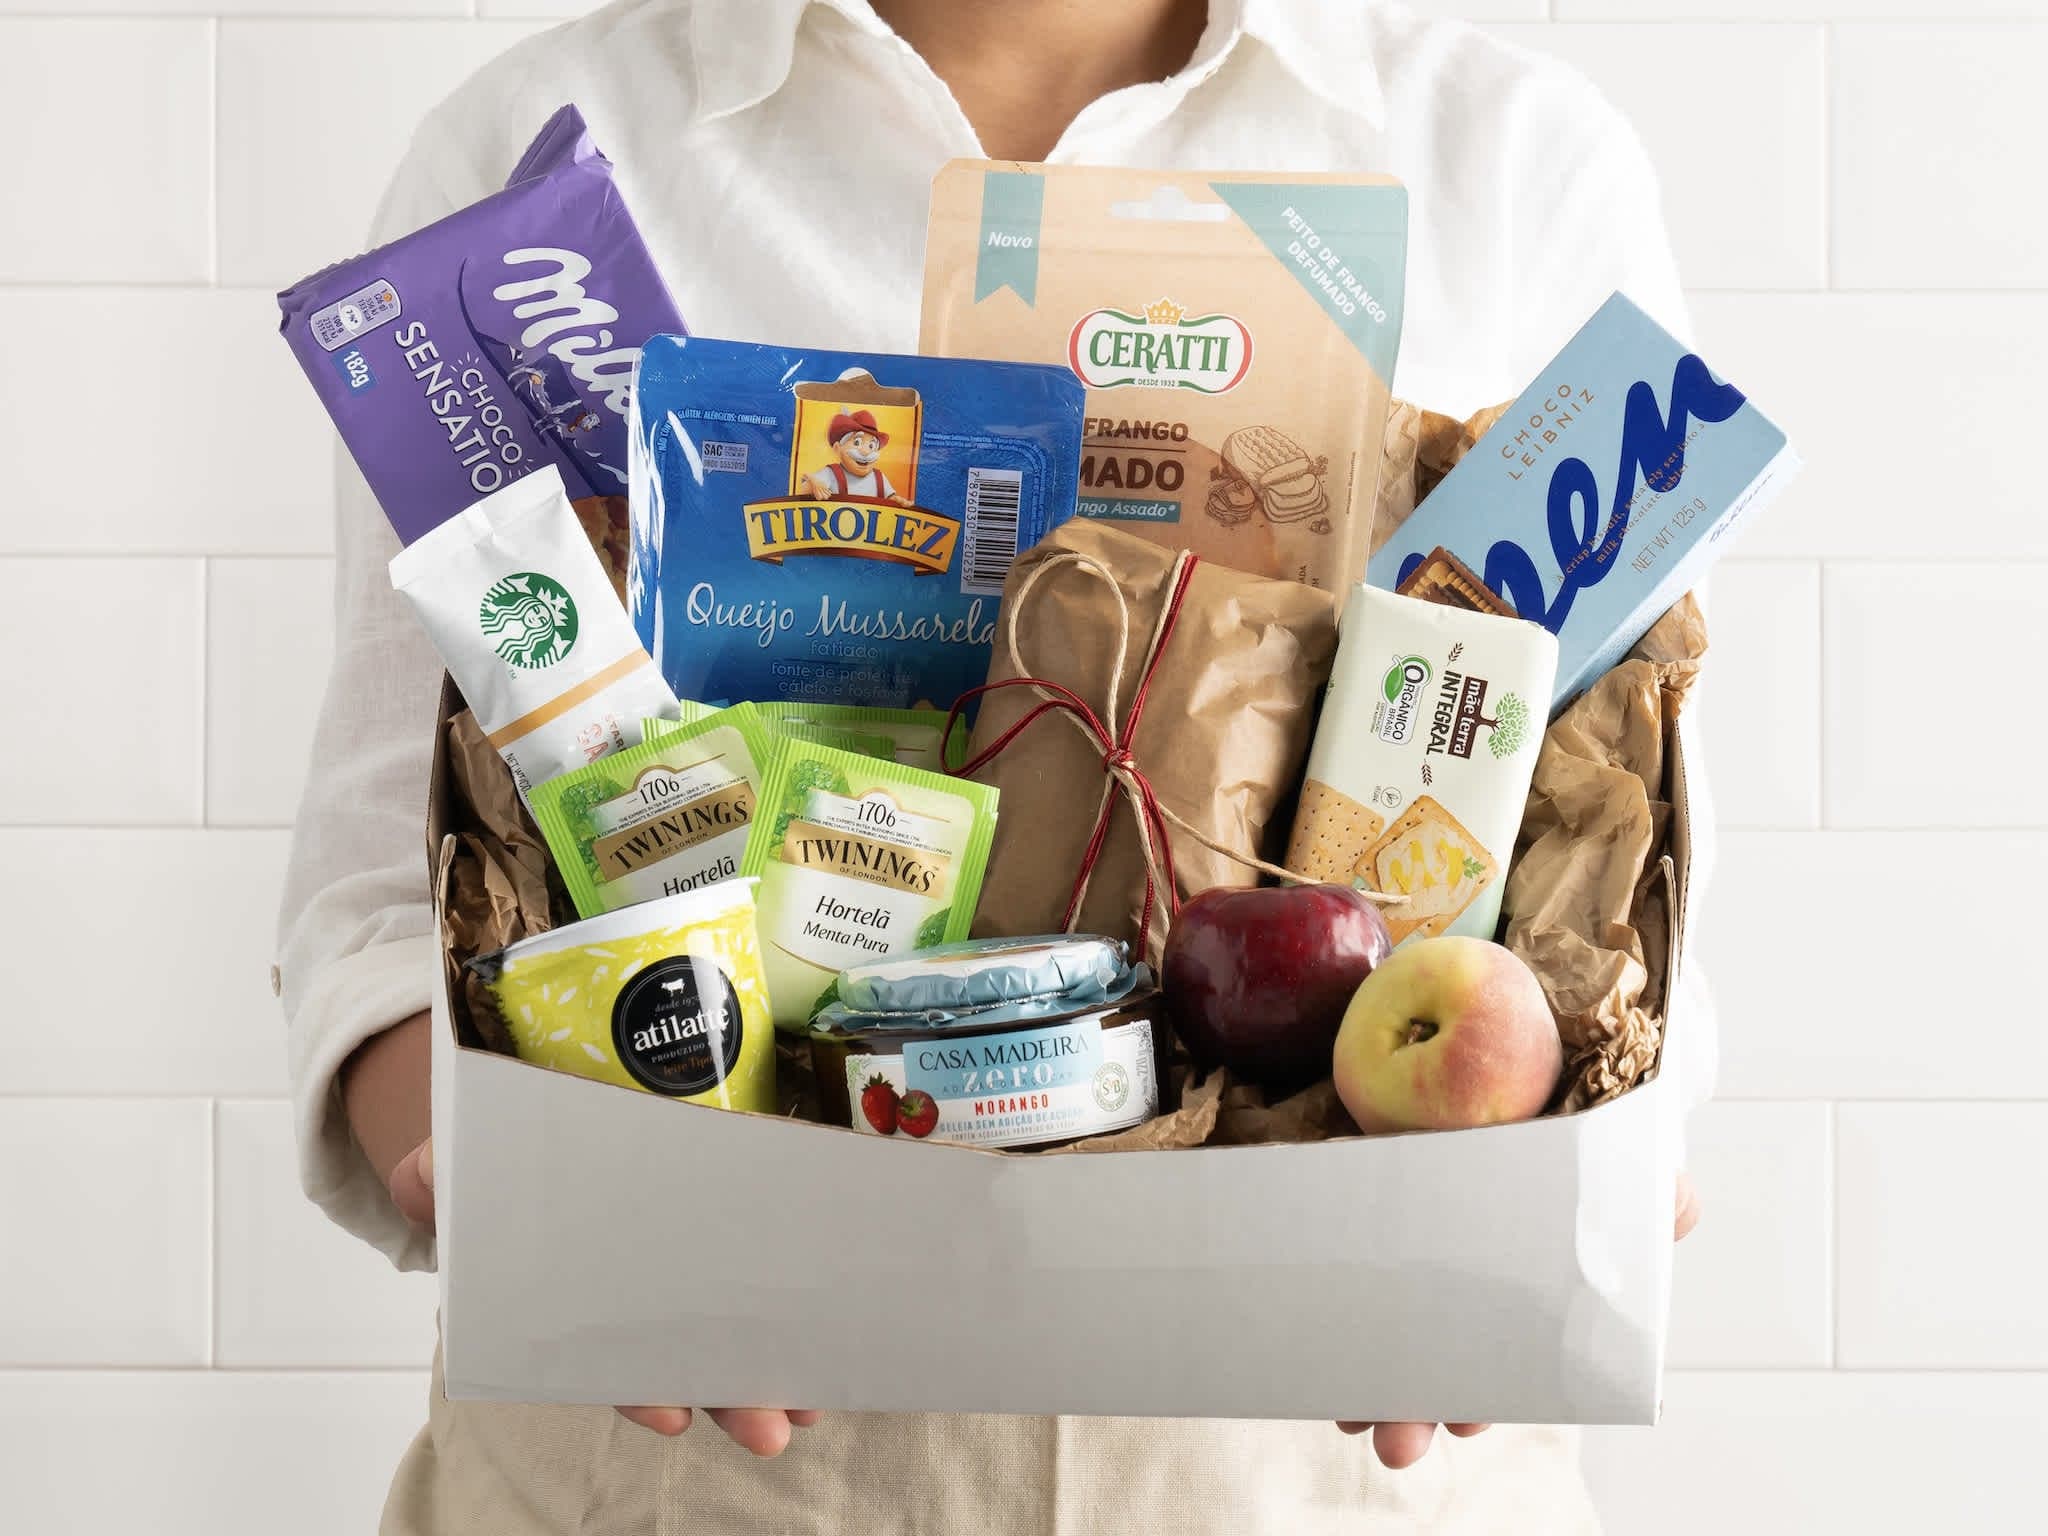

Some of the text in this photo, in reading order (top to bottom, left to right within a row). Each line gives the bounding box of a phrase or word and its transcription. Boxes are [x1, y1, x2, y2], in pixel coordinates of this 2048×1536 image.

[988, 231, 1033, 249] Novo
[1281, 206, 1386, 323] PEITO DE FRANGO
[1287, 240, 1355, 315] DEFUMADO
[493, 247, 641, 424] Milk
[1089, 329, 1231, 374] CERATTI
[344, 350, 370, 387] 182g
[1138, 378, 1176, 387] DESDE 1932
[394, 320, 503, 494] SENSATIO
[461, 367, 523, 465] CHOCO
[1501, 384, 1571, 459] CHOCO
[1083, 417, 1189, 442] FRANGO
[1508, 389, 1594, 480] LEIBNIZ
[704, 443, 723, 457] SAC
[1079, 456, 1185, 492] MADO
[1079, 502, 1107, 516] ngo
[1566, 548, 1591, 574] crisp
[1663, 452, 1679, 469] set
[750, 506, 950, 560] TIROLEZ
[1596, 538, 1619, 564] milk
[1632, 497, 1707, 574] NET WT 125 g
[686, 582, 997, 648] Queijo Mussarela
[810, 640, 880, 658] fatiado
[770, 662, 810, 677] fonte
[815, 665, 835, 679] de
[778, 678, 828, 696] cálcio
[1383, 707, 1396, 737] BRASIL
[1426, 670, 1463, 757] INTEGRAL
[1454, 678, 1483, 756] mãe terra
[640, 776, 680, 804] 1706
[857, 801, 896, 828] 1706
[609, 800, 748, 870] TWININGS
[675, 832, 709, 849] LONDON
[663, 856, 736, 897] Hortelã
[796, 839, 936, 893] TWININGS
[853, 870, 888, 883] LONDON
[815, 895, 891, 929] Hortelã
[803, 921, 889, 954] Menta Pura
[634, 1008, 730, 1052] atilatte
[651, 1042, 705, 1064] PRODUZIDO
[919, 1034, 1089, 1071] CASA MADEIRA
[961, 1062, 1055, 1093] zero
[975, 1094, 1049, 1116] MORANGO
[976, 1118, 995, 1129] SEM
[1035, 1112, 1048, 1123] DE
